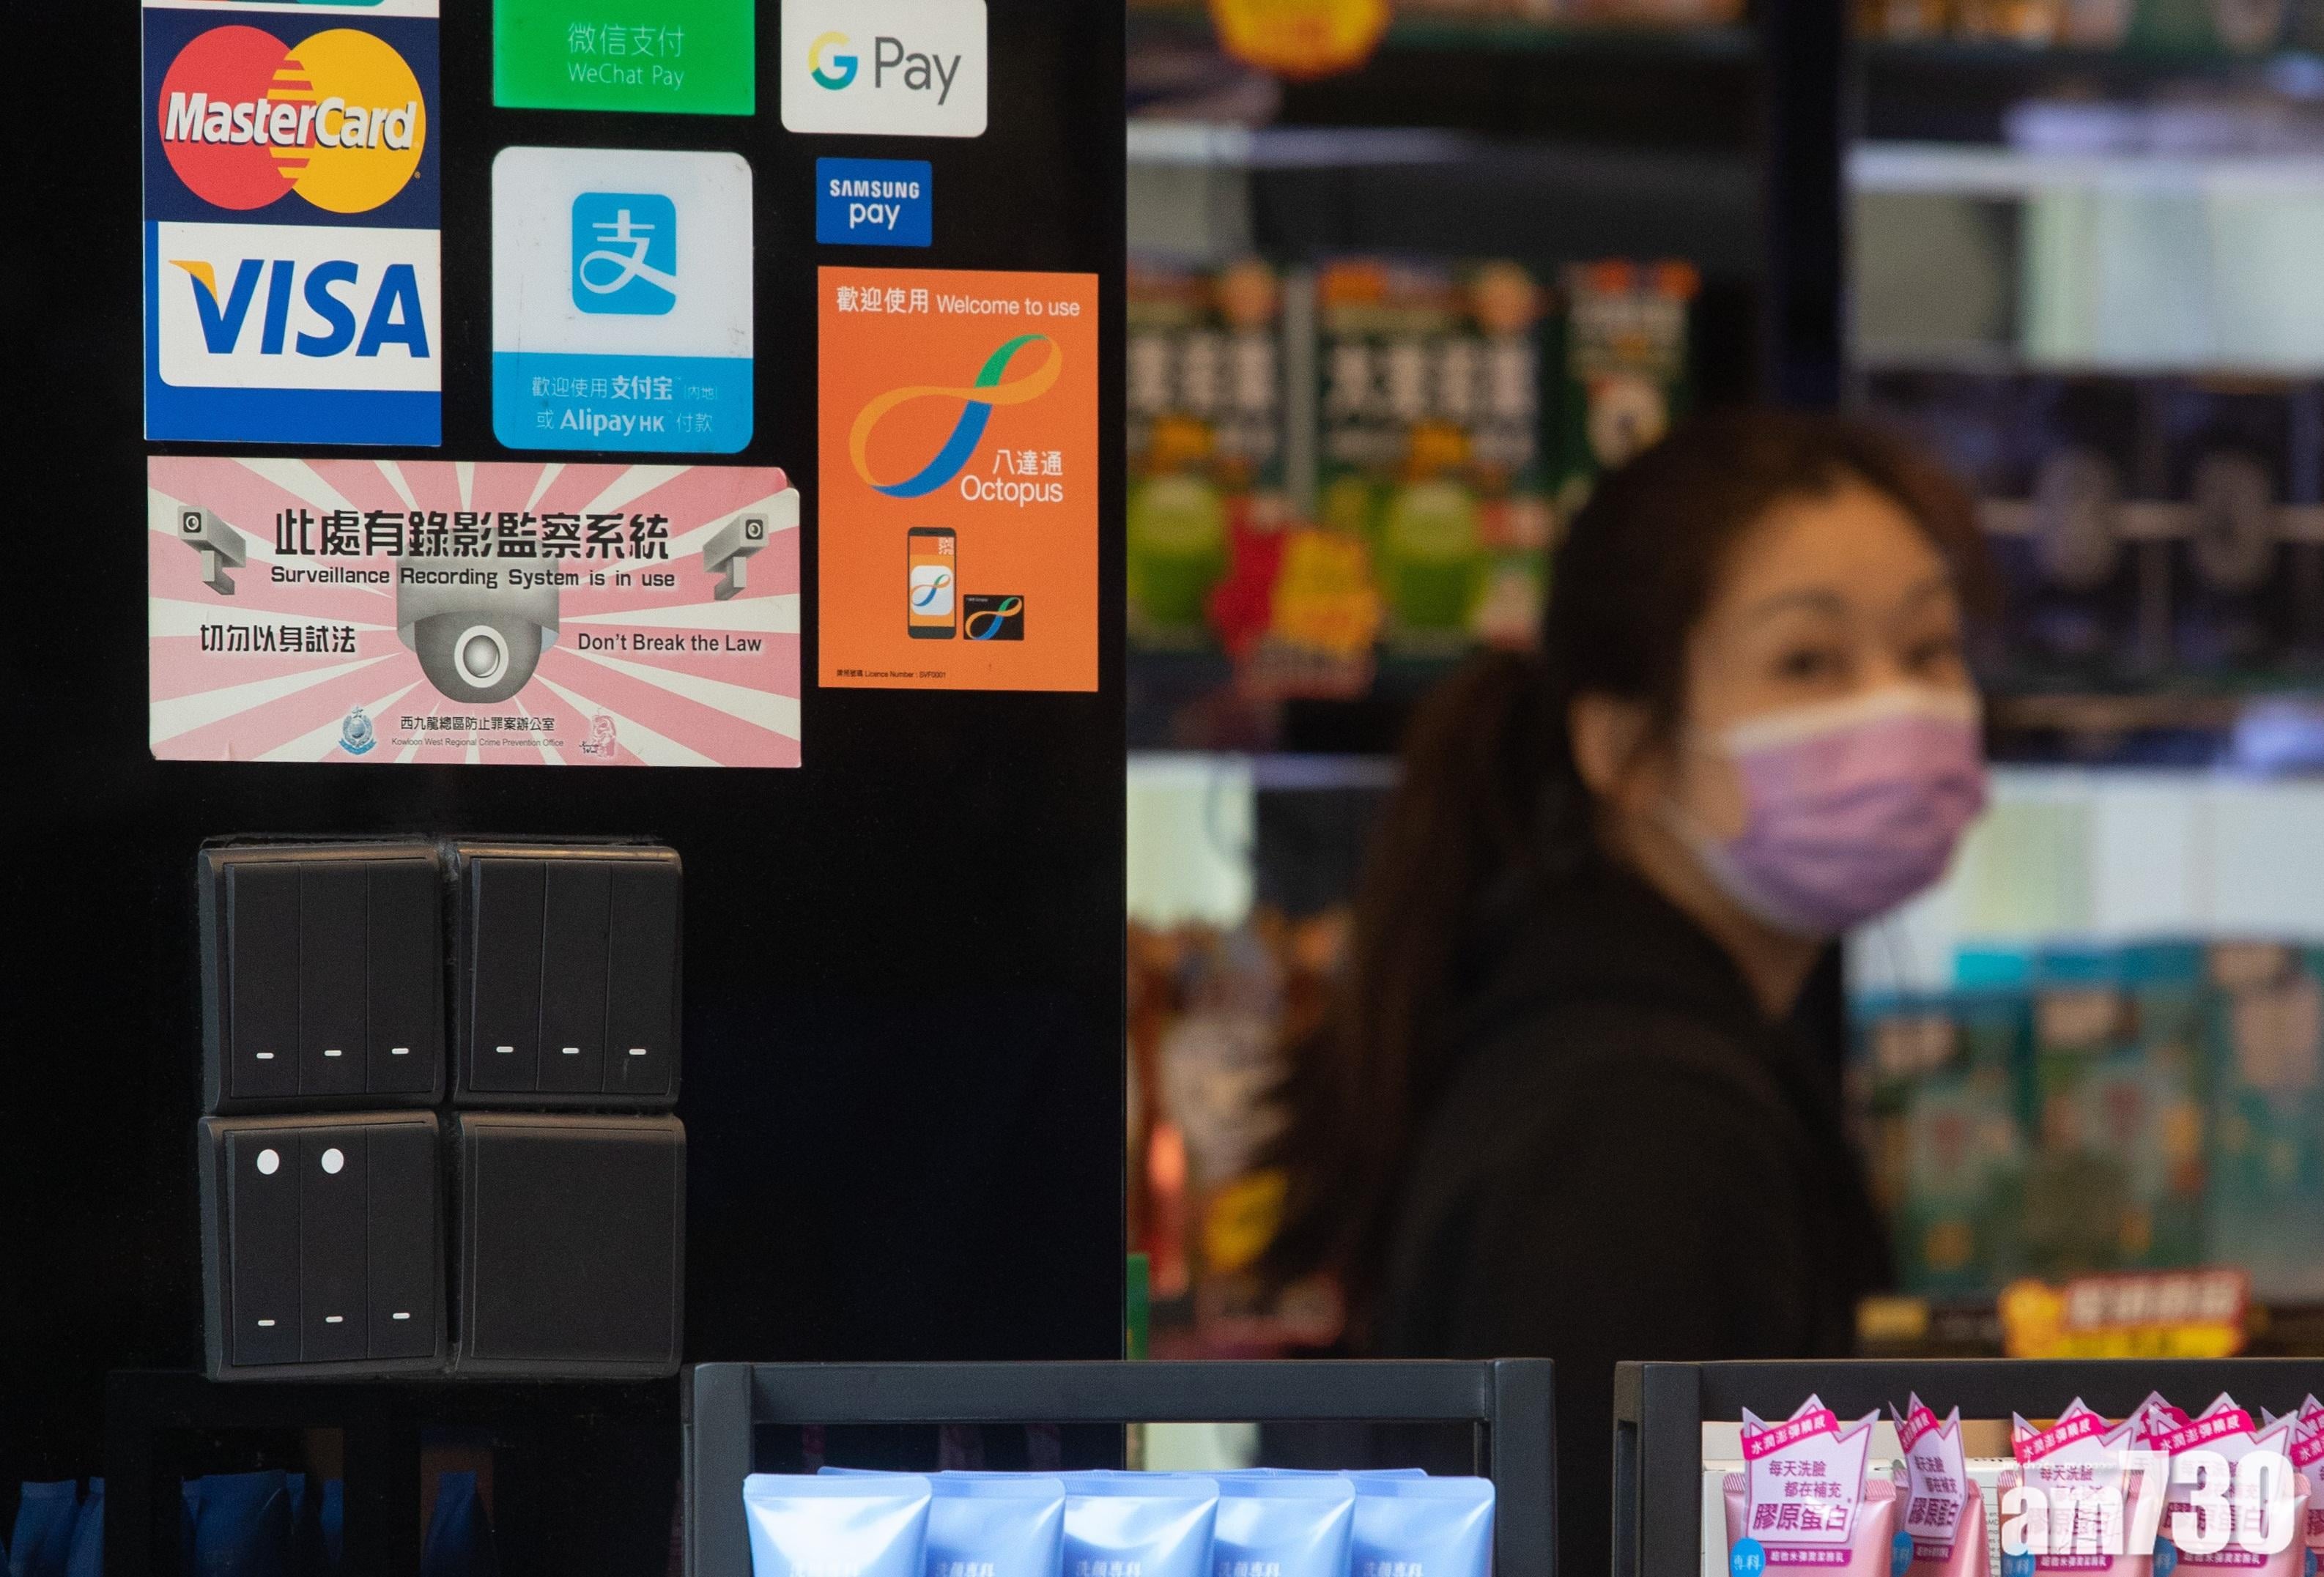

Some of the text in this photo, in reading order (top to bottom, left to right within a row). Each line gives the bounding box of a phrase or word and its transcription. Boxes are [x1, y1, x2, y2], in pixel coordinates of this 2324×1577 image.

[568, 23, 685, 58] 微信支付
[568, 62, 684, 91] WeChat Pay
[874, 36, 962, 106] Pay
[164, 92, 418, 151] MasterCard
[829, 179, 920, 199] SAMSUNG
[849, 201, 901, 231] pay
[168, 259, 431, 358] VISA
[836, 286, 1081, 316] 歡迎使用 Welcome to use
[536, 410, 555, 429] 或
[676, 412, 713, 434] 付款
[992, 449, 1064, 476] 八達通
[961, 474, 1064, 508] Octopus
[275, 508, 669, 560] 此處有錄影監察系統
[271, 565, 675, 590] Surveillance Recording System is in use
[200, 624, 356, 653] 切勿以身試法
[632, 633, 685, 651] Break
[691, 634, 719, 652] the
[725, 634, 762, 652] Law
[391, 738, 564, 747] Kowloon West Regional Crime Prevention Office
